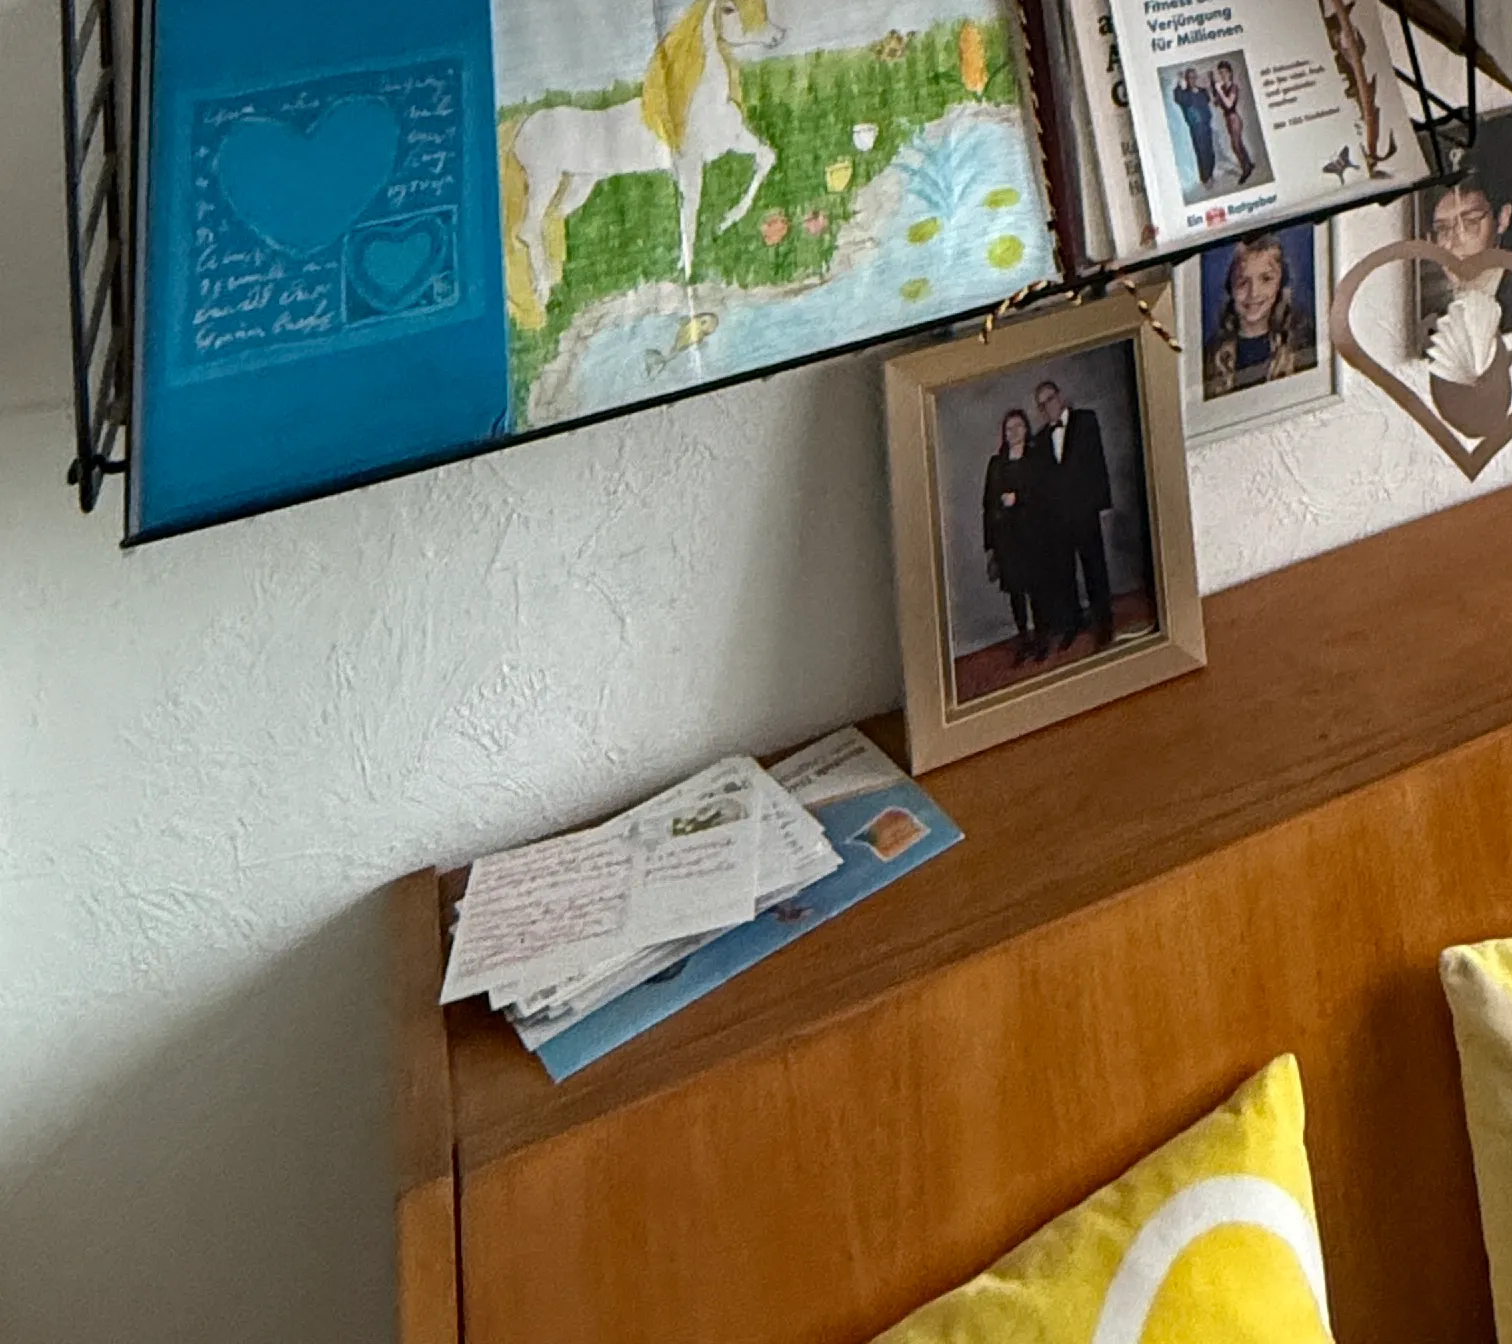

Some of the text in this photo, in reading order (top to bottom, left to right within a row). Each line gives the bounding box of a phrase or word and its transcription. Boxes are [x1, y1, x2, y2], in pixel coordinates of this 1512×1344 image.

[1145, 5, 1234, 37] Verjüngung
[1149, 20, 1245, 53] für Millionen
